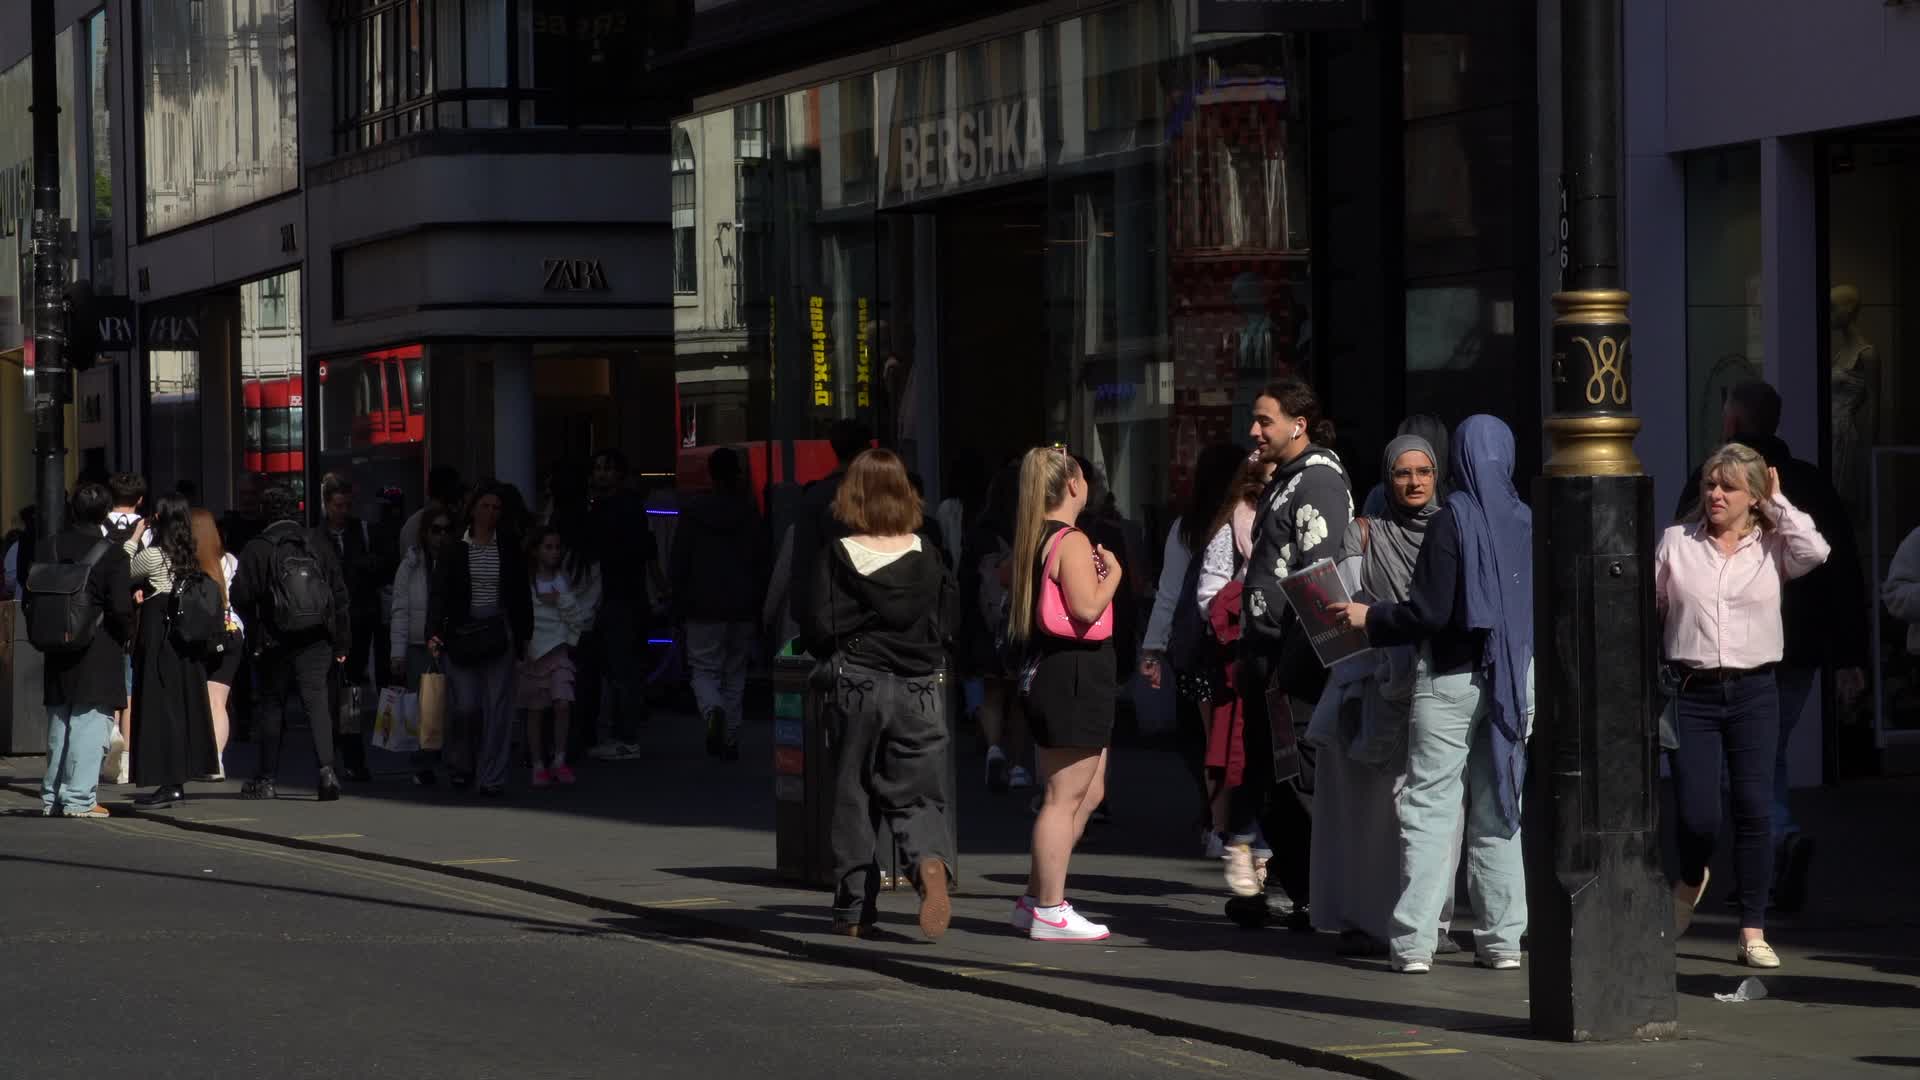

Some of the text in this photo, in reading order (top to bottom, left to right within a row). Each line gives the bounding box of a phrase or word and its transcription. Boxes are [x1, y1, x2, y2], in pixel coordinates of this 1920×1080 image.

[901, 98, 1046, 191] BERSHKA
[1560, 189, 1569, 268] 106
[543, 257, 609, 289] ZARA
